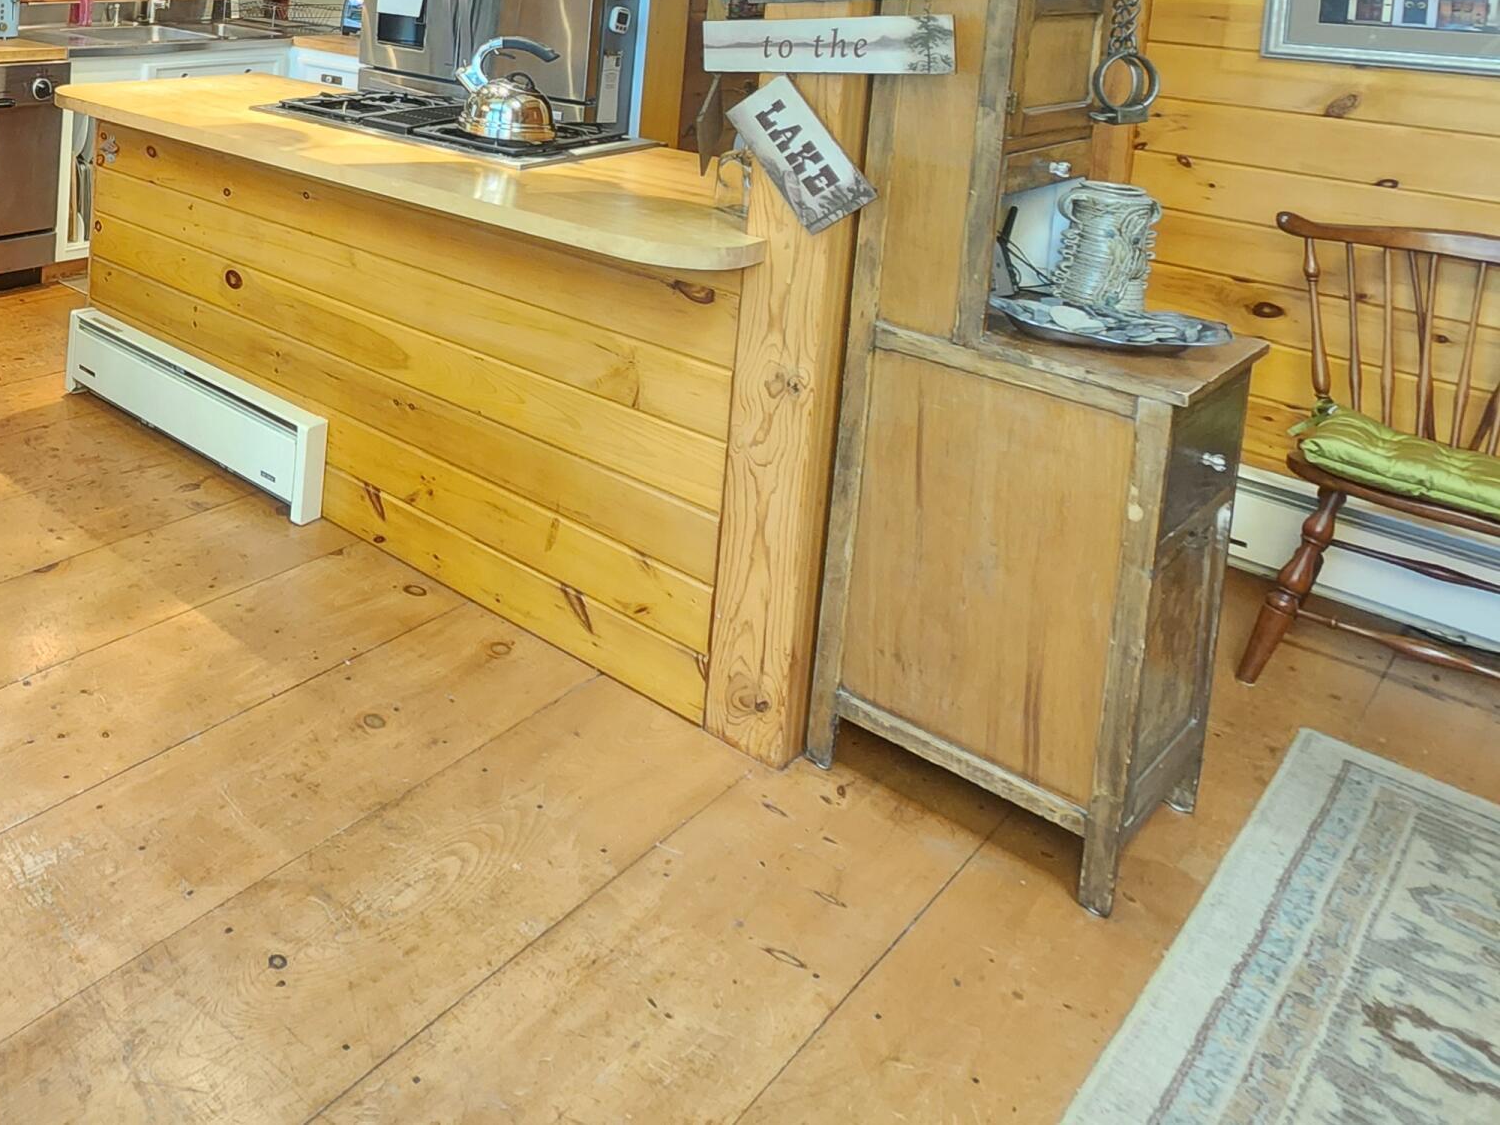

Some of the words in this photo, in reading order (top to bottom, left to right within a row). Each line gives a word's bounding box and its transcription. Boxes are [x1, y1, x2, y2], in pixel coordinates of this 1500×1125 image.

[762, 34, 794, 59] to
[813, 27, 869, 59] the
[754, 98, 841, 198] LAKE
